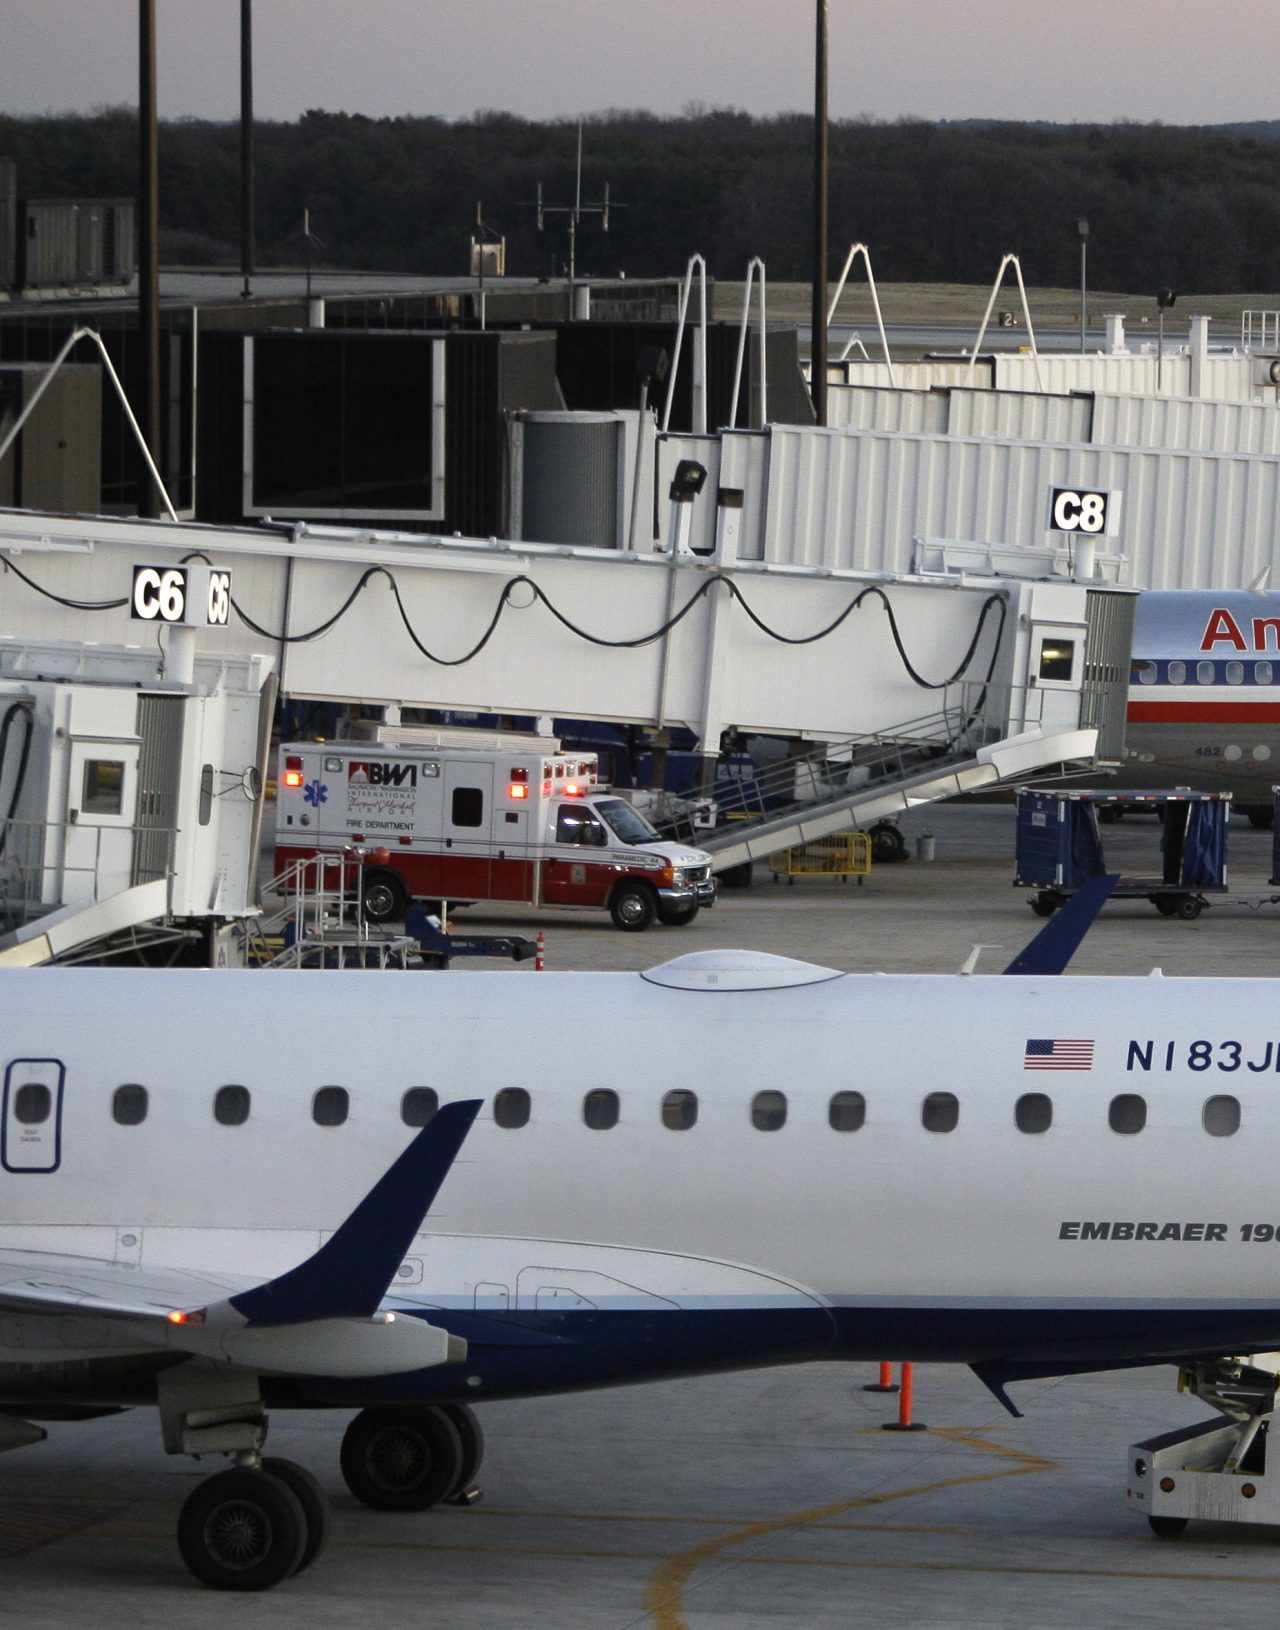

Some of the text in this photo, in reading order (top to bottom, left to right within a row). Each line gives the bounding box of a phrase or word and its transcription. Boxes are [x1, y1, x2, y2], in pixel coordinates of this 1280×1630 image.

[1054, 491, 1105, 533] C8
[134, 568, 185, 621] C6
[208, 573, 230, 624] C6
[369, 762, 417, 788] BWI
[347, 790, 416, 800] INTERNATIONAL
[346, 819, 415, 831] FIRE DEPARTMENT
[1058, 1221, 1228, 1242] EMBRAER
